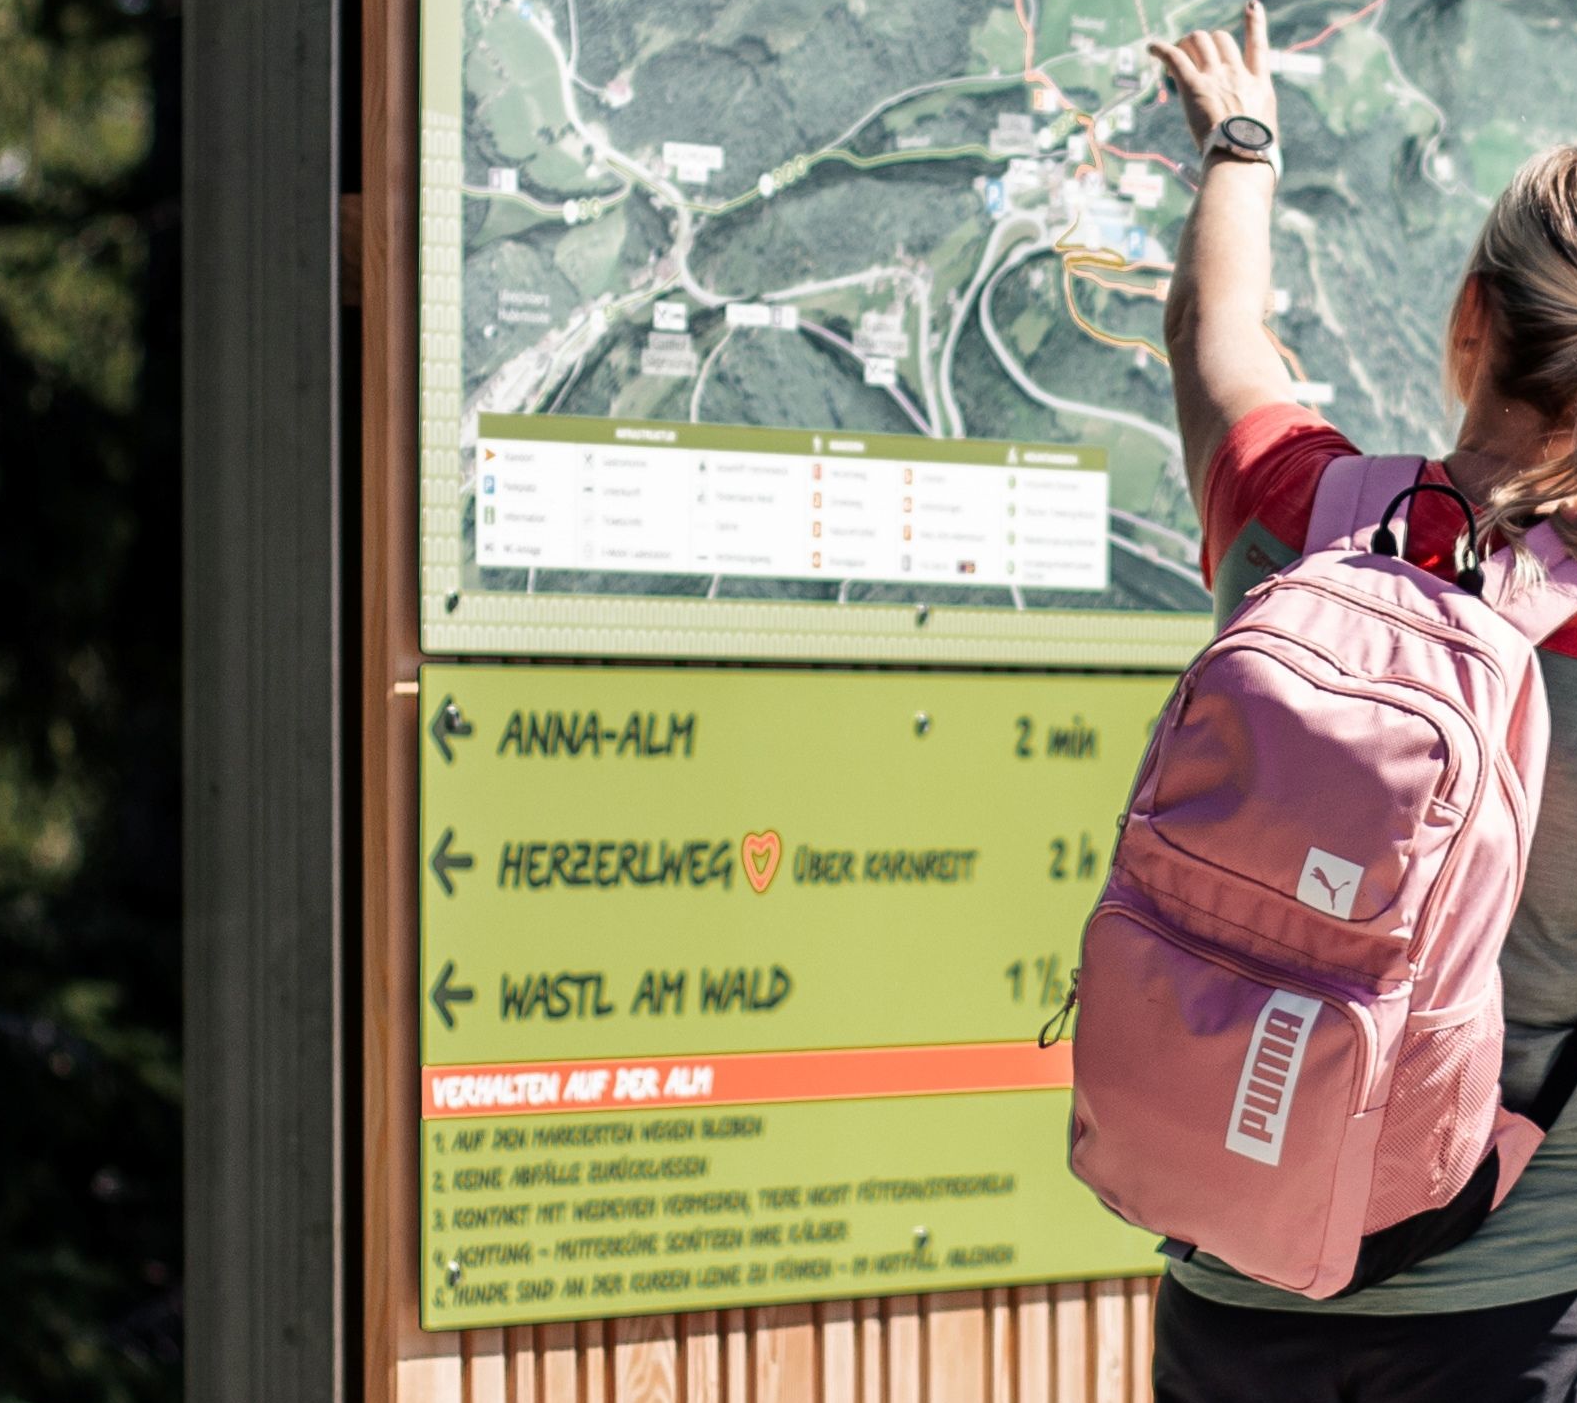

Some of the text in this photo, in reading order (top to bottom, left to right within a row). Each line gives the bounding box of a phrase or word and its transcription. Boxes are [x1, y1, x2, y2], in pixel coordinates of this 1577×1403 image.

[497, 710, 697, 758] ANNA-ALM
[1015, 715, 1033, 759] 2
[1048, 714, 1098, 758] min
[498, 840, 735, 890] HERZERLWEG
[793, 846, 854, 886] ÜBER
[1050, 837, 1067, 881] 2
[1076, 830, 1097, 880] h
[499, 970, 614, 1021] WASTL
[630, 968, 686, 1016] AM
[699, 964, 793, 1015] WALD
[1005, 959, 1023, 1002] 1
[431, 1066, 715, 1108] VERHALTEN AUF DER ALM
[1237, 1006, 1305, 1145] PUMA
[451, 1204, 532, 1230] KONTAKT
[453, 1242, 532, 1270] ACHTUNG
[452, 1283, 509, 1308] HUNDE
